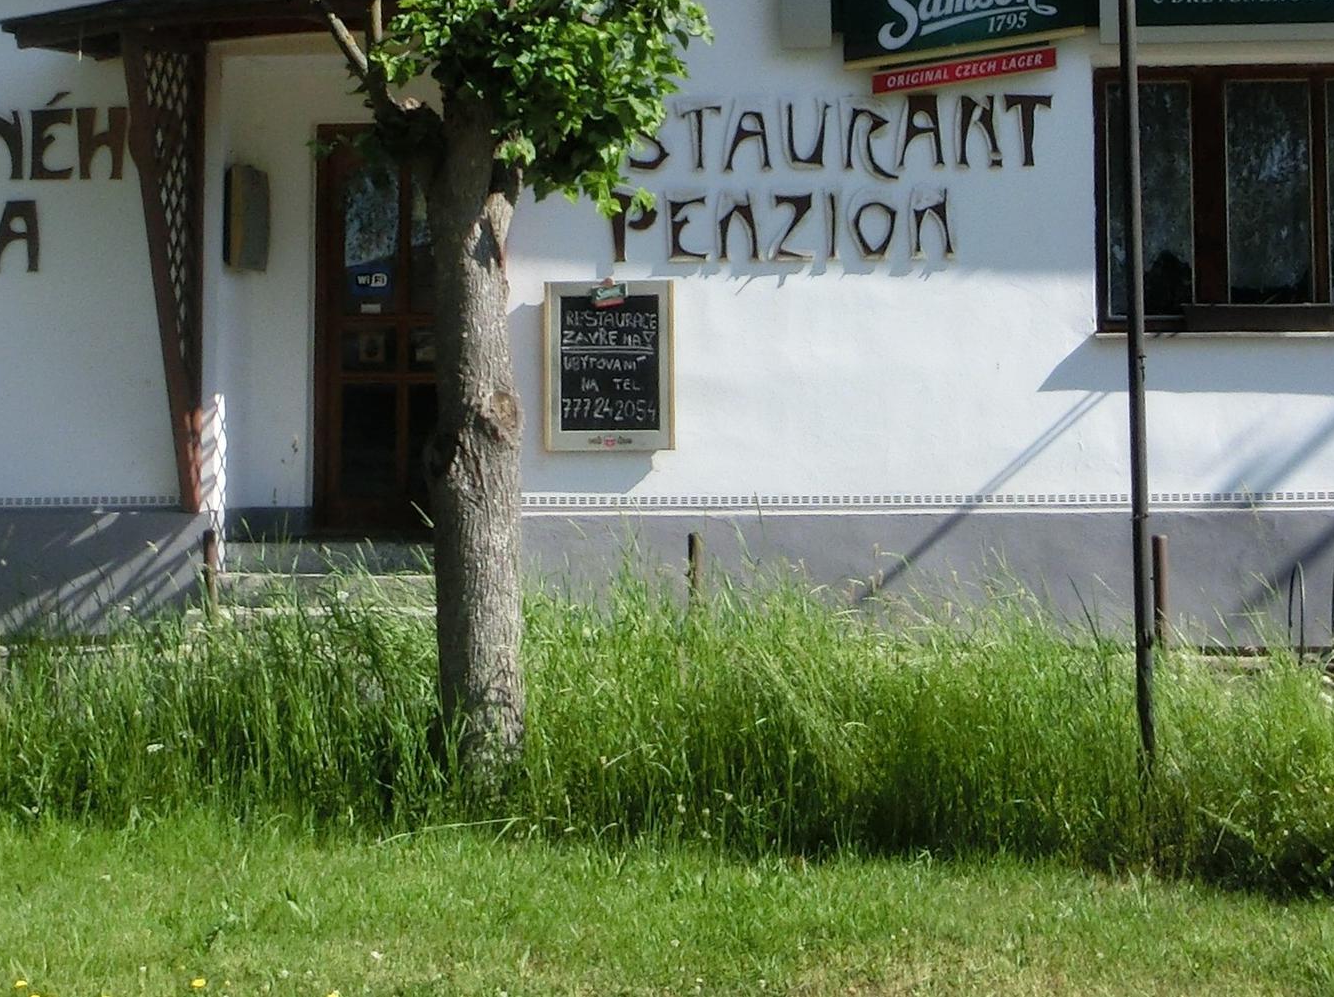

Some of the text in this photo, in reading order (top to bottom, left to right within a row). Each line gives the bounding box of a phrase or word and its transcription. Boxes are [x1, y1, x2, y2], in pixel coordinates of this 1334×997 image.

[987, 11, 1029, 34] 1795
[886, 53, 1043, 89] ORIGINAL CZECH LAGER
[628, 94, 1053, 180] STAURANT
[612, 188, 955, 263] PENZION
[580, 377, 600, 392] NA
